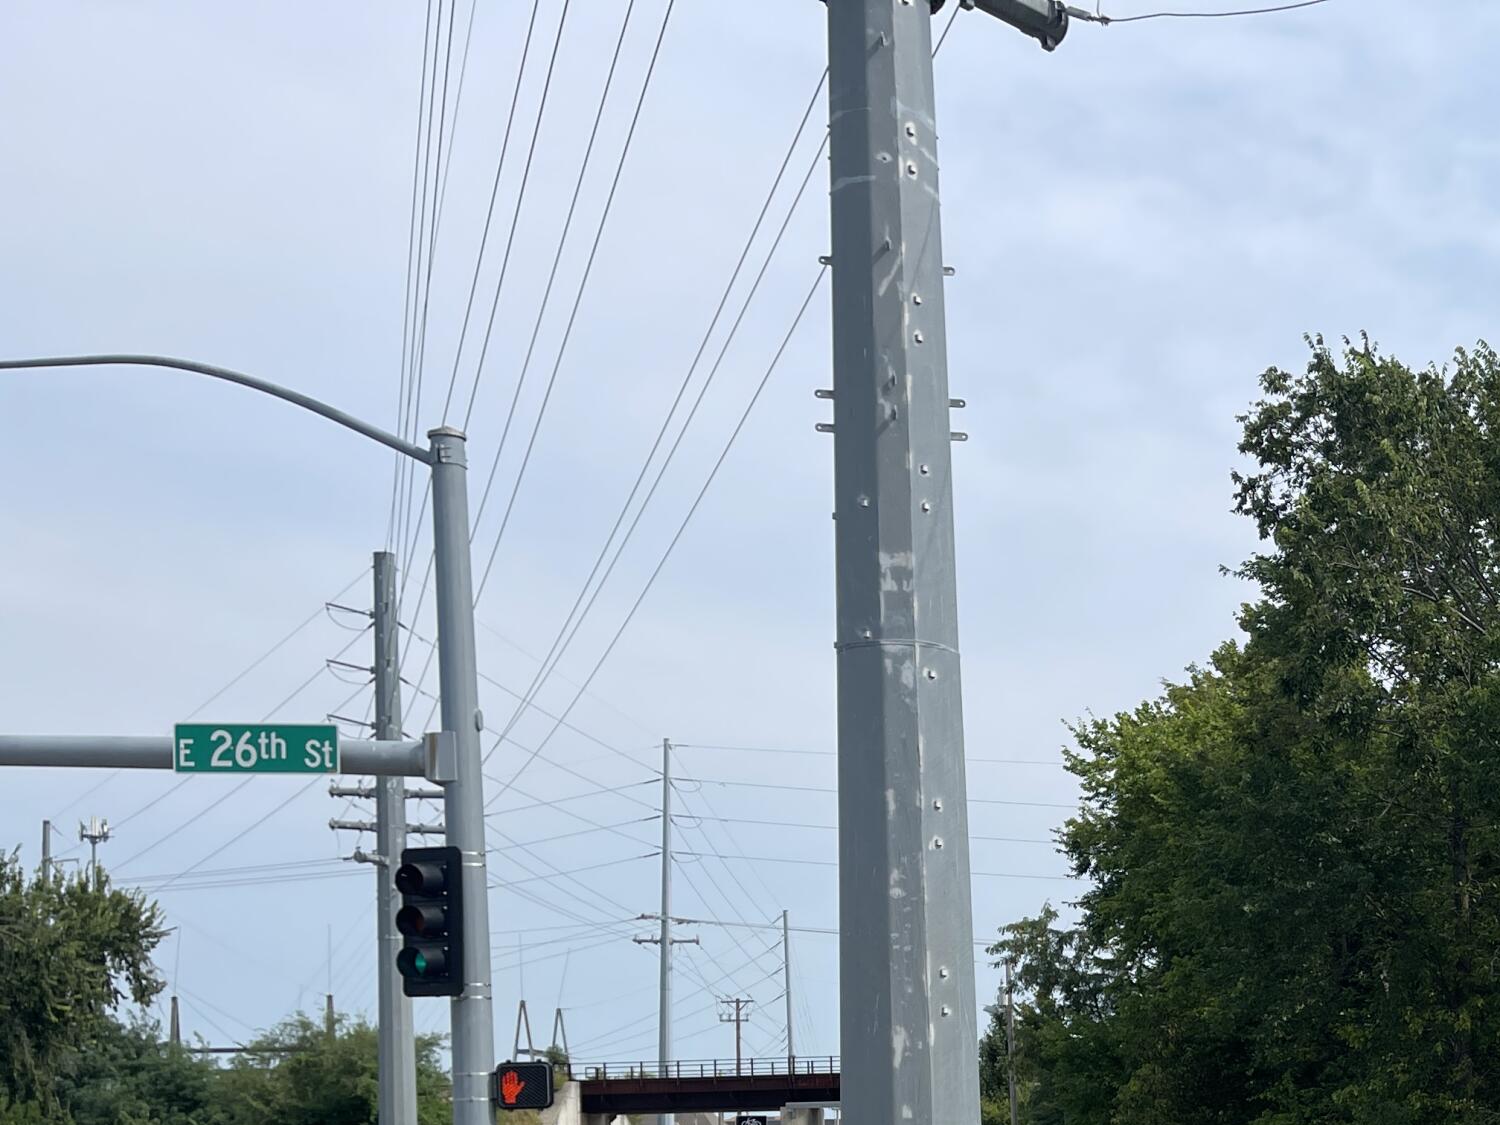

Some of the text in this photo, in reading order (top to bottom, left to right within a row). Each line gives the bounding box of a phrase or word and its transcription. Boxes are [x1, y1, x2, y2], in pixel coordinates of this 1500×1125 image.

[179, 729, 333, 768] E 26th St
